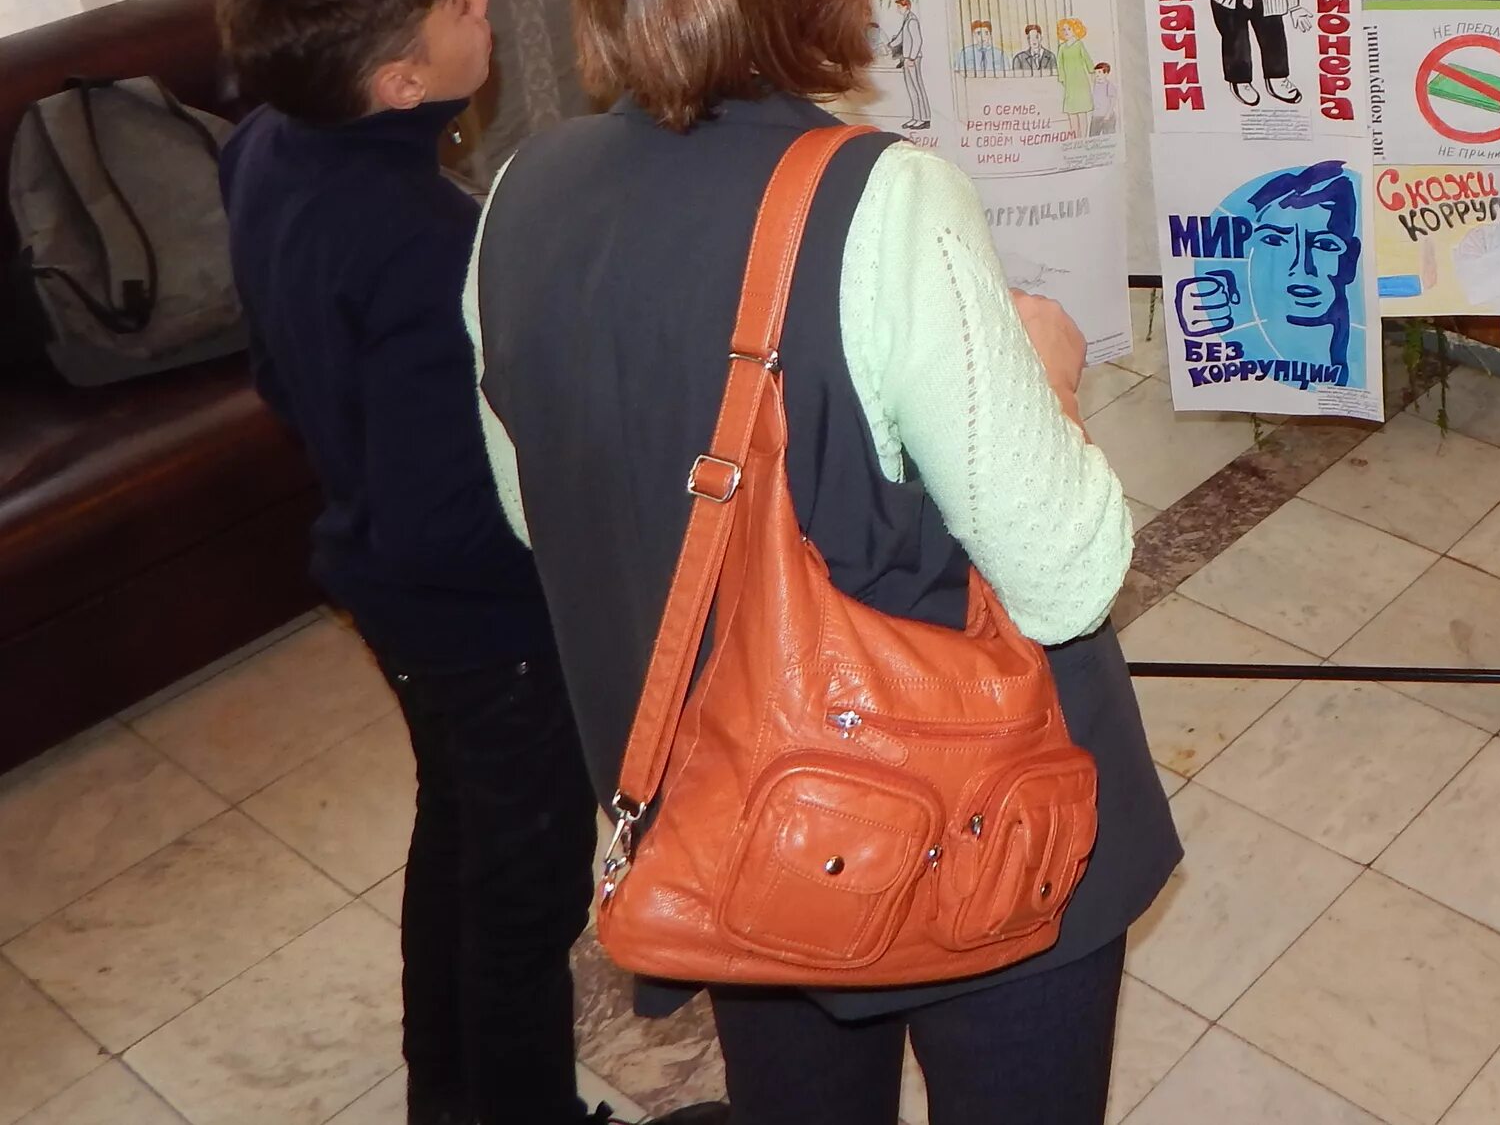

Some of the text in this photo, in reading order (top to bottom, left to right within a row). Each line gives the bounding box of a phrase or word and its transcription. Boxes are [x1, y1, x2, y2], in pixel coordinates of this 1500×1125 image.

[1433, 24, 1451, 40] НЕ
[1363, 25, 1386, 124] коррупции!
[1019, 129, 1077, 146] честном
[977, 152, 1021, 164] имени
[1438, 145, 1456, 158] НЕ
[984, 197, 1090, 227] ОРРУПЦИИ
[1168, 214, 1254, 259] МИР
[1184, 338, 1245, 362] БЕЗ
[1188, 359, 1342, 391] КОРРУПЦИИ
